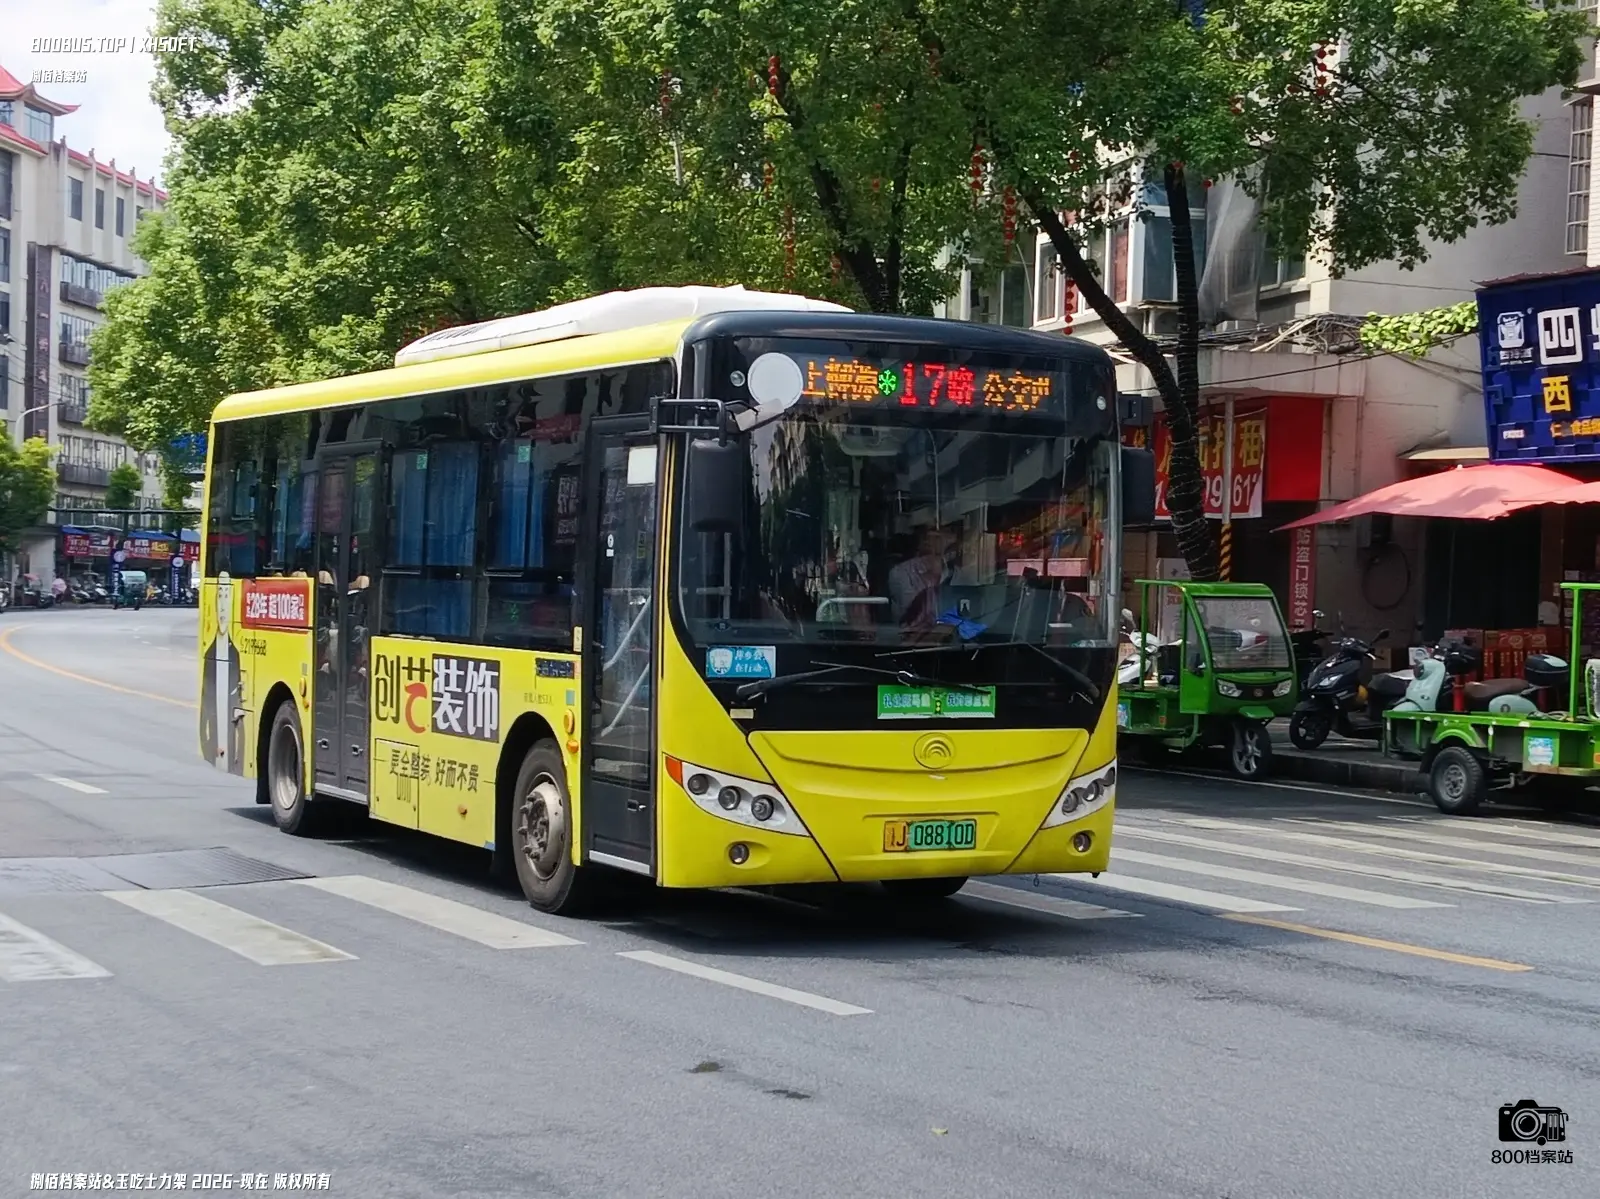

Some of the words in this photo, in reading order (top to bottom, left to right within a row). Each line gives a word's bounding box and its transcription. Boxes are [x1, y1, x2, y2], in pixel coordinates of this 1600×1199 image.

[374, 653, 499, 739] 创艺装饰
[434, 756, 480, 793] 好而不贵
[889, 823, 975, 847] J08810D
